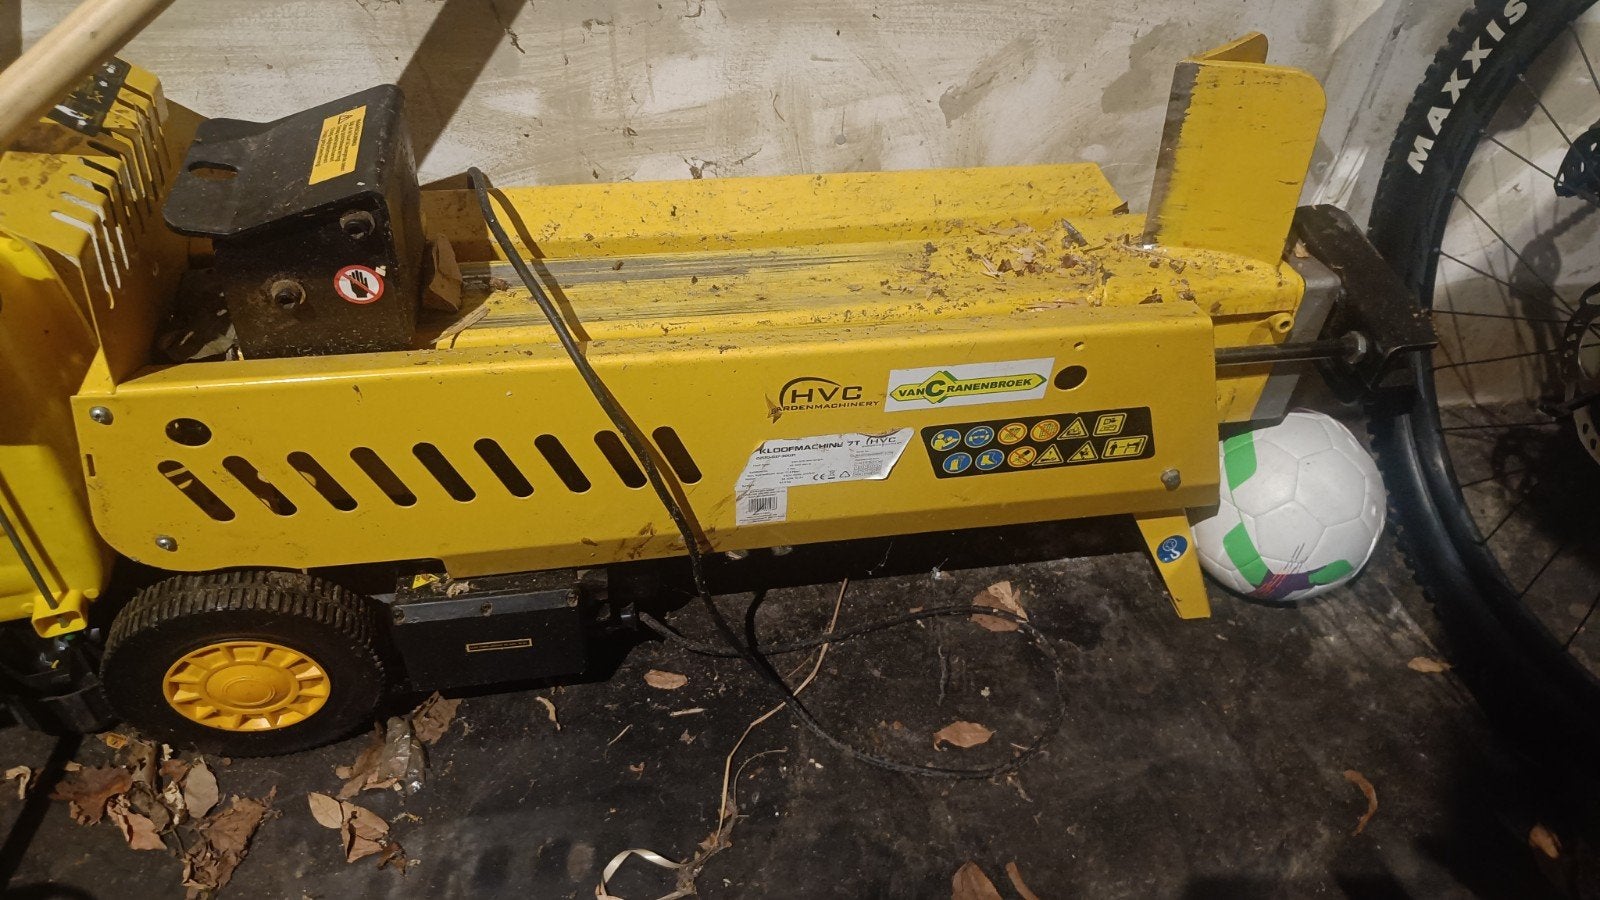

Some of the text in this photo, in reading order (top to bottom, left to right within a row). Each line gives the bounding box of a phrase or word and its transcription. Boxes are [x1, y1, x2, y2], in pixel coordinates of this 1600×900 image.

[1407, 0, 1528, 175] MAXXIS
[790, 385, 863, 404] HVC
[898, 386, 926, 398] VAN
